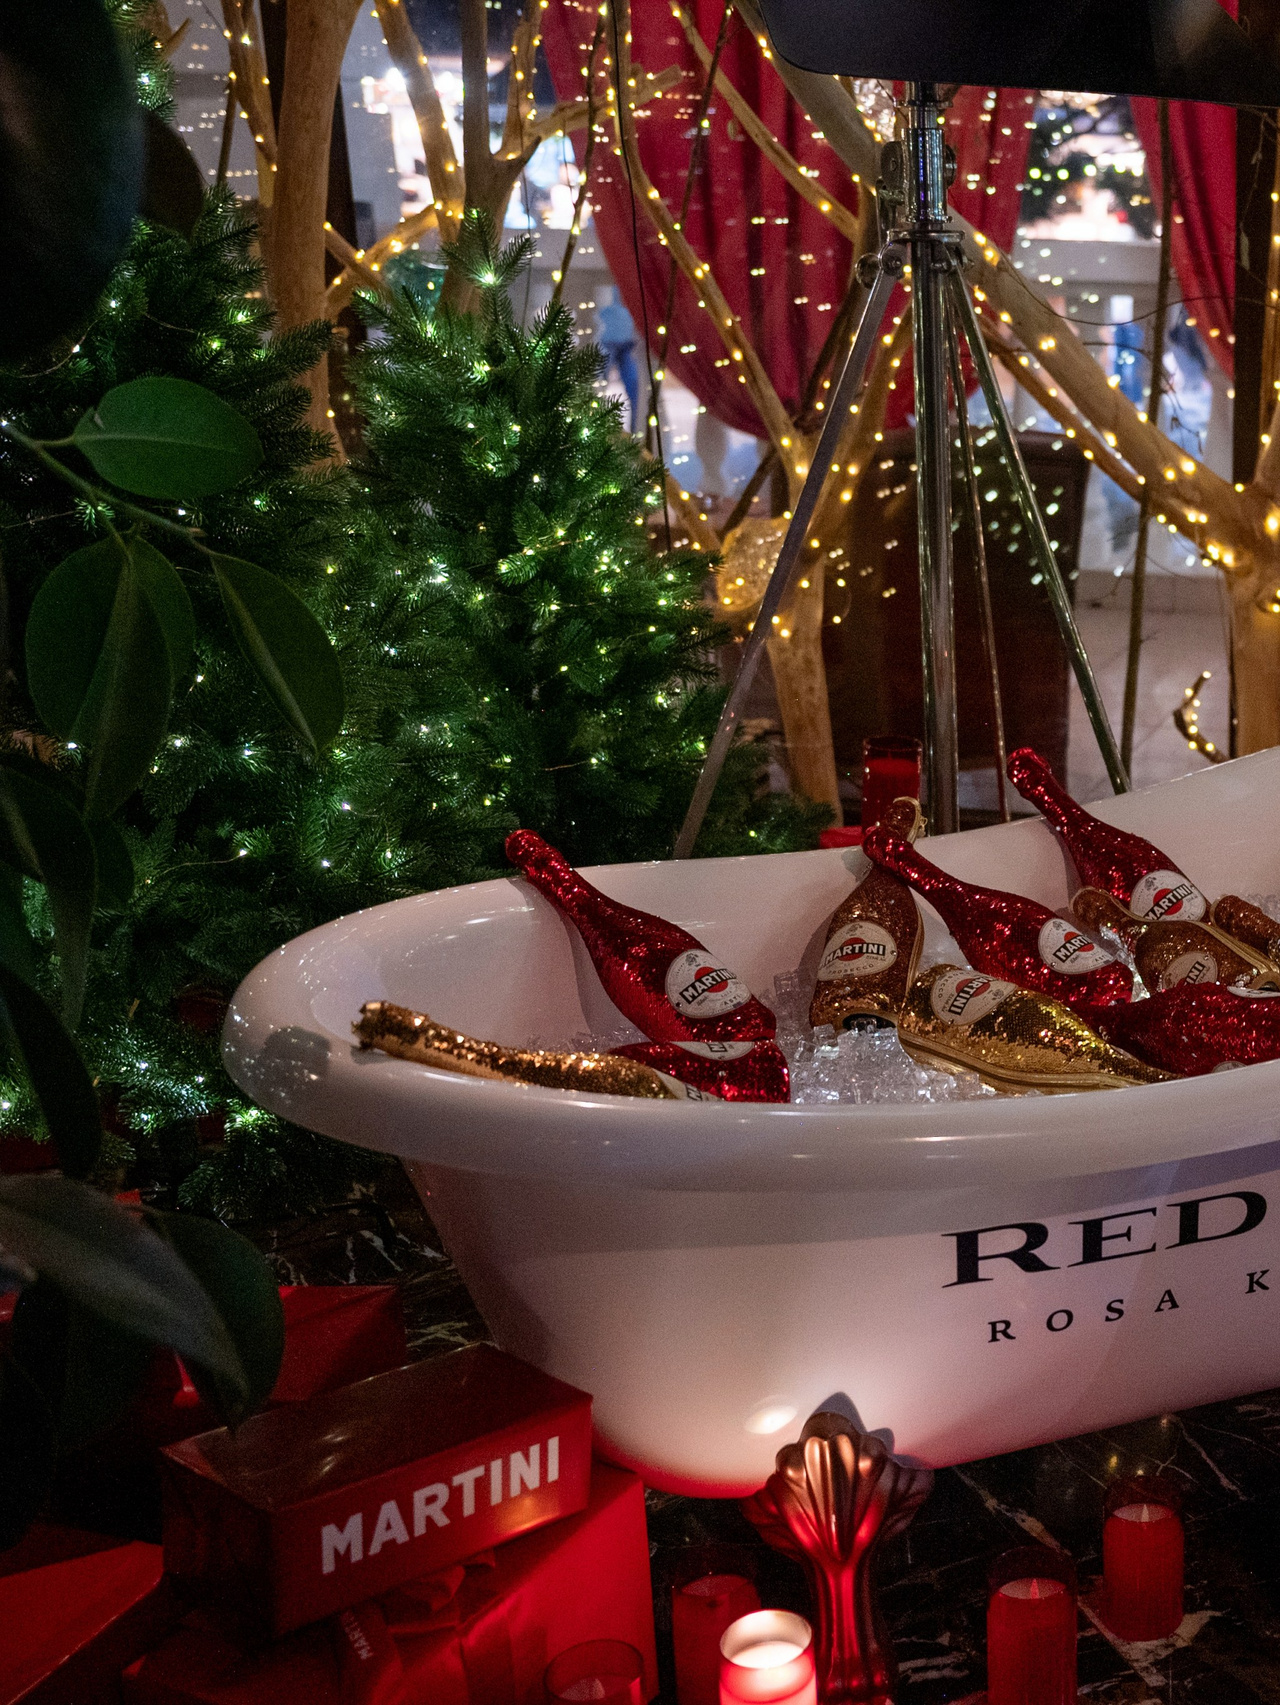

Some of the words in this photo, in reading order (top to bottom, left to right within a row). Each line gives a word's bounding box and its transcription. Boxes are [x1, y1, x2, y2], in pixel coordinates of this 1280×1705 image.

[941, 1190, 1268, 1289] RED
[987, 1288, 1181, 1344] ROSA
[320, 1435, 561, 1575] MARTINI
